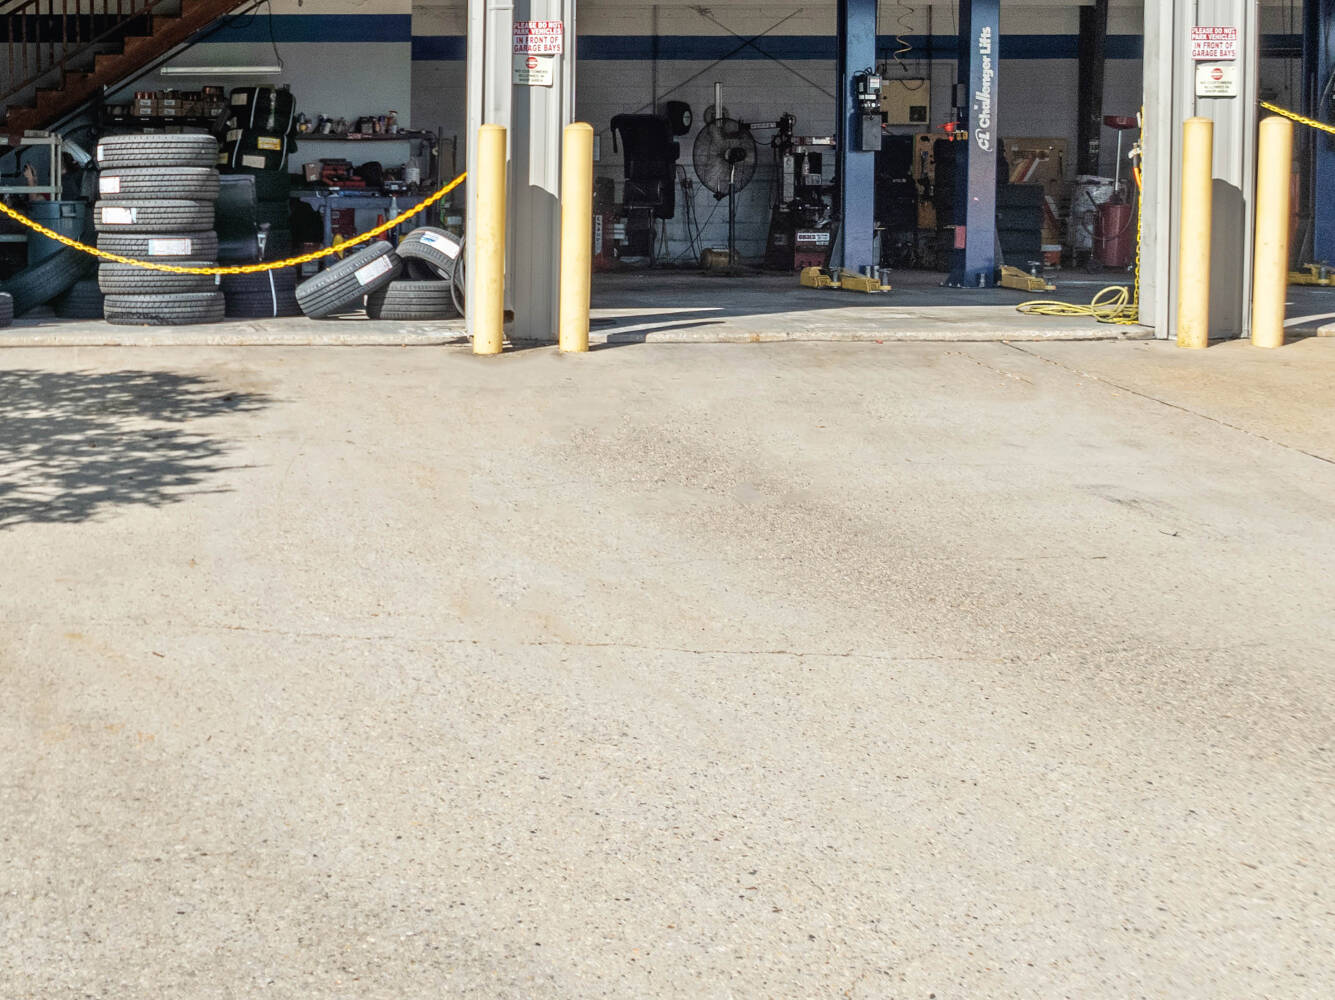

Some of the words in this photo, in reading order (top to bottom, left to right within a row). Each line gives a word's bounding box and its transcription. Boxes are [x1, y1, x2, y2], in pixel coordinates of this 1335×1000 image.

[516, 36, 523, 44] IN
[526, 36, 548, 44] FRONT
[550, 36, 558, 44] OF
[979, 26, 992, 55] Lifts
[514, 44, 541, 52] GARAGE
[544, 44, 561, 52] BAYS
[1192, 49, 1218, 57] GARAGE
[1220, 49, 1236, 57] BAYS
[975, 55, 994, 128] Challenger
